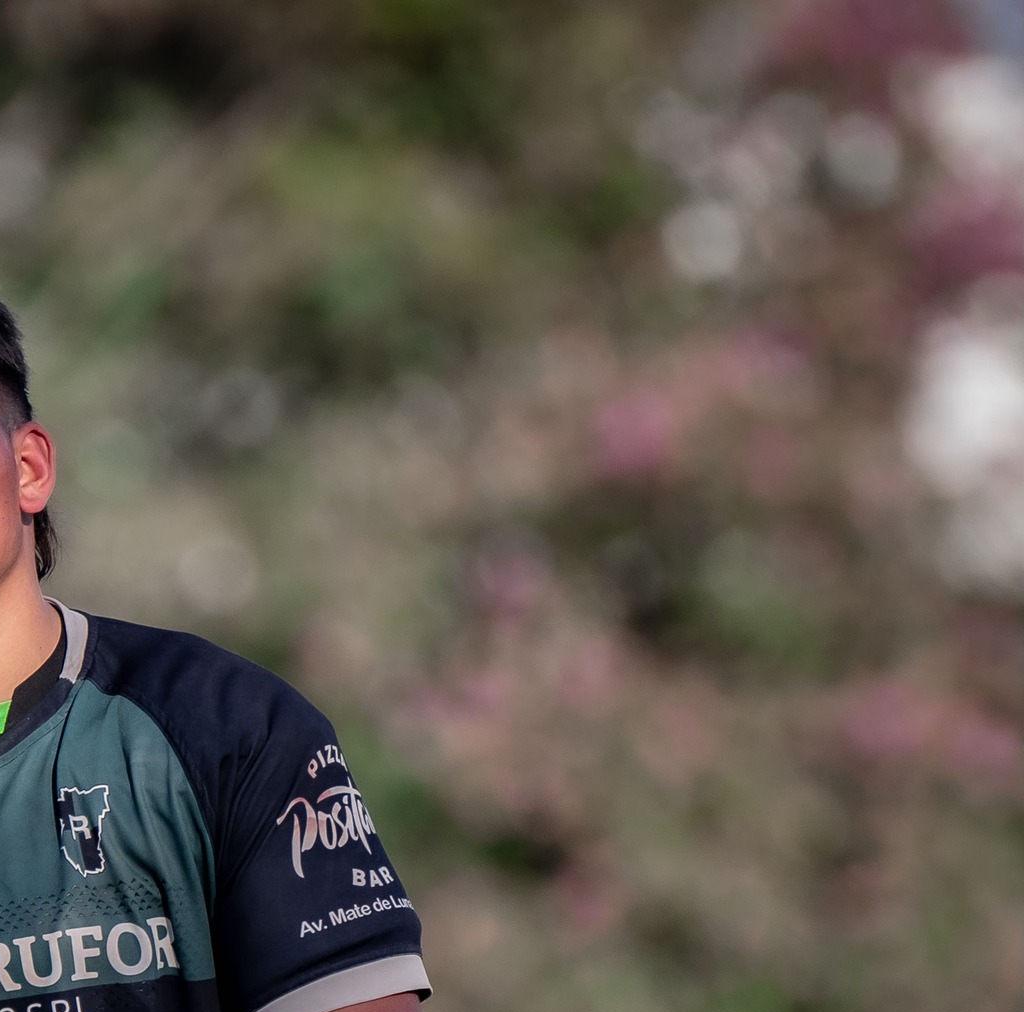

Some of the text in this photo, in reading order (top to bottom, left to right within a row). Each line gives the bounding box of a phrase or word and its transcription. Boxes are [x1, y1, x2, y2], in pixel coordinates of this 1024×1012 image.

[68, 814, 92, 840] R
[352, 866, 394, 888] BAR
[300, 920, 328, 938] Av.
[329, 903, 372, 926] Mate
[372, 896, 392, 913] de
